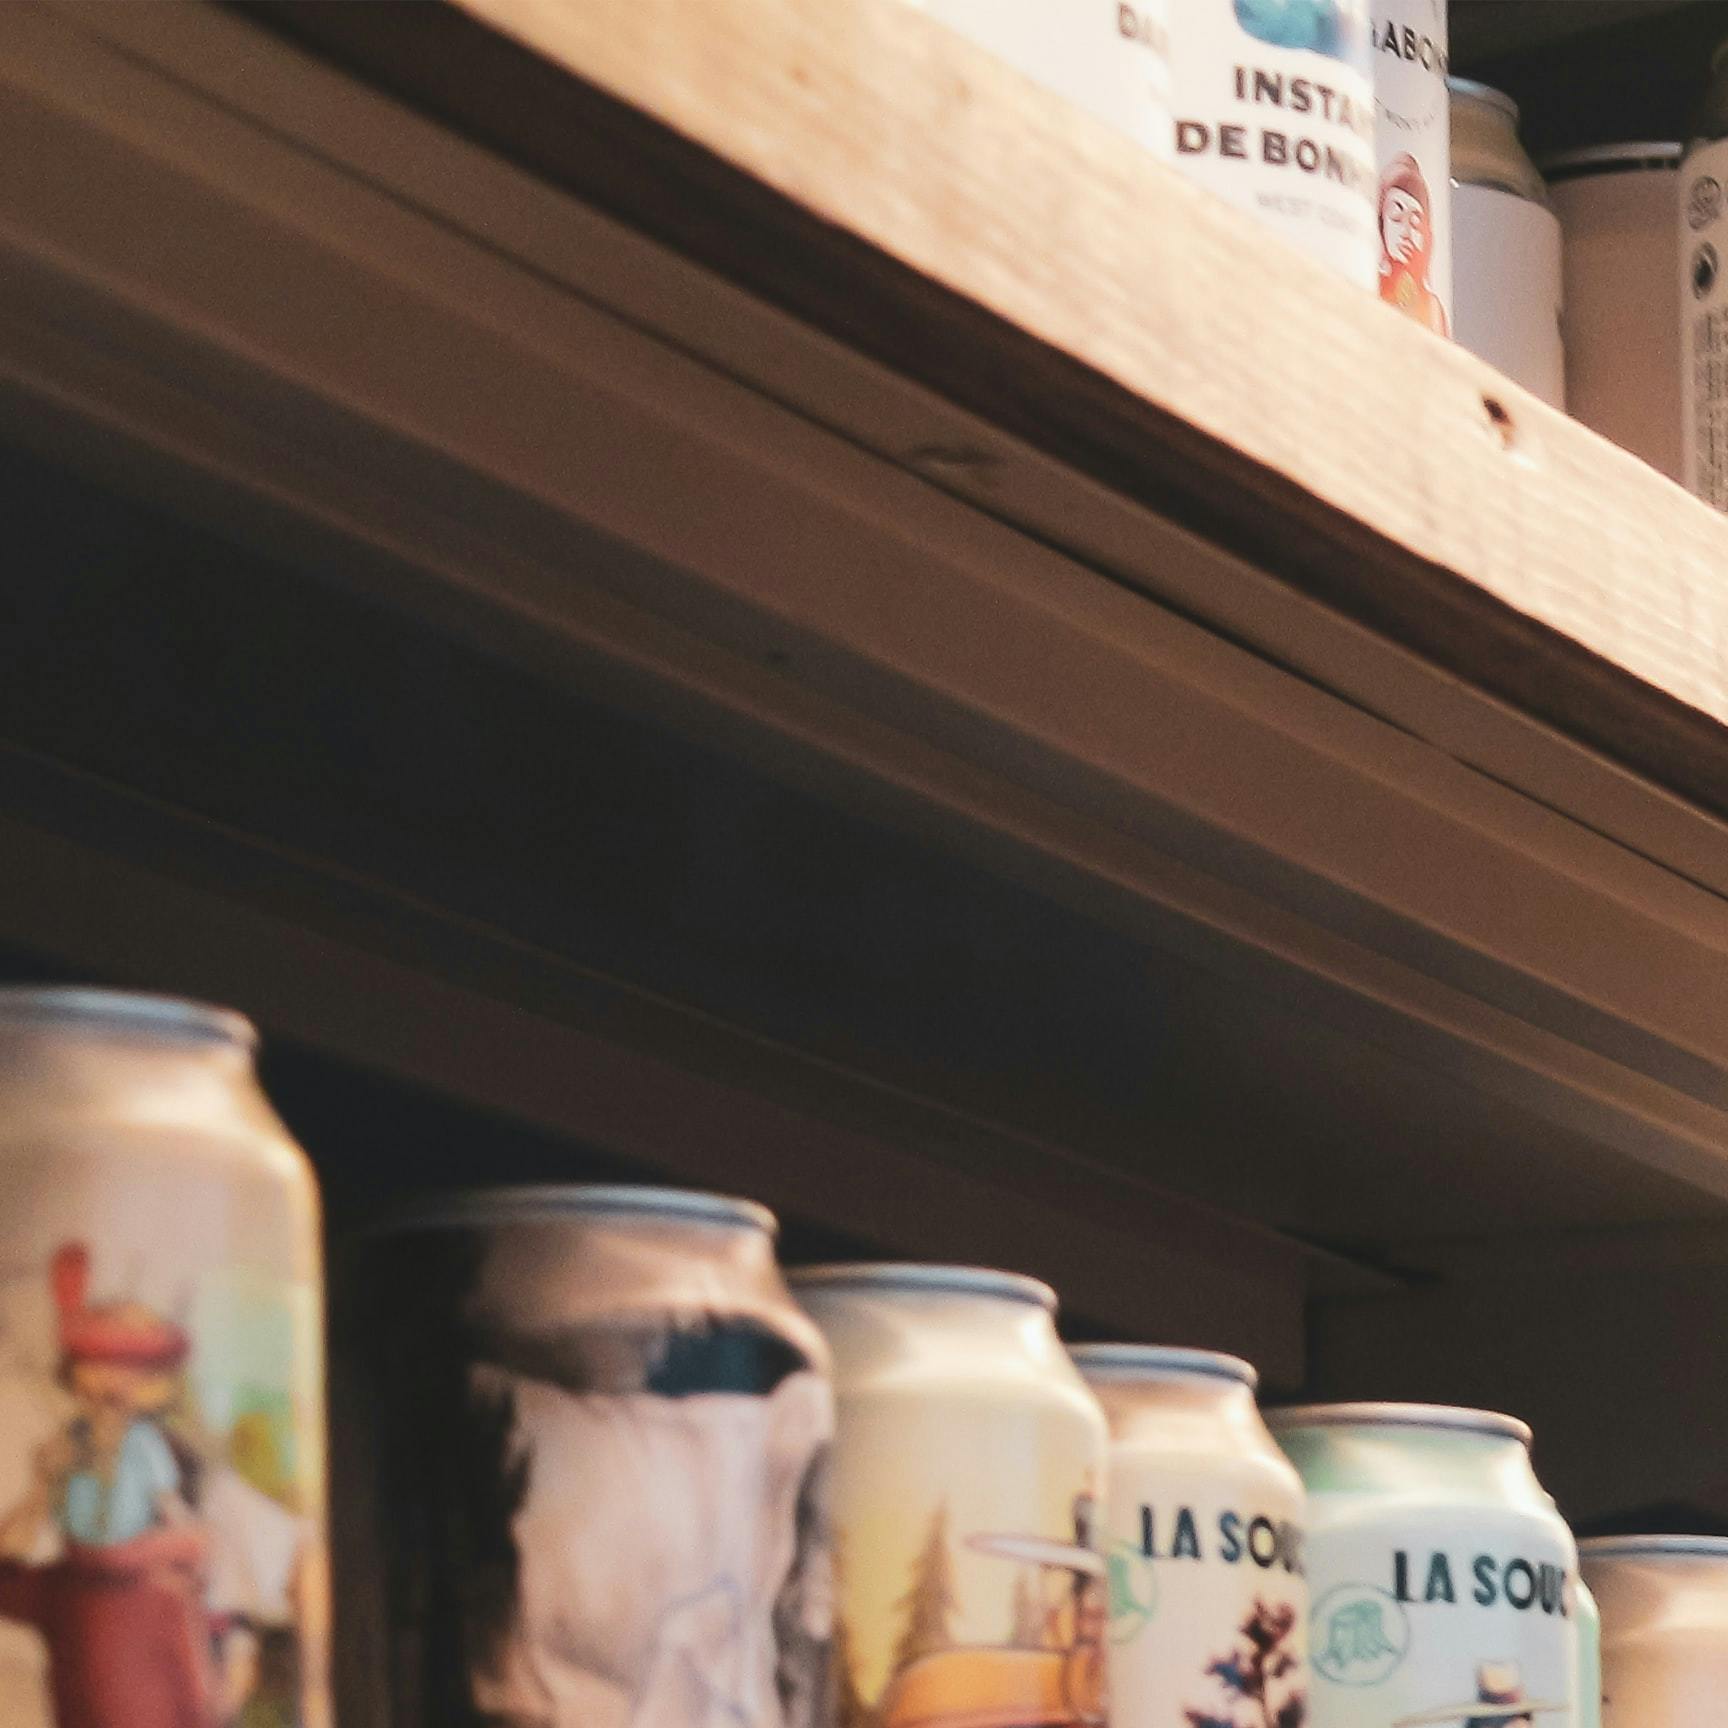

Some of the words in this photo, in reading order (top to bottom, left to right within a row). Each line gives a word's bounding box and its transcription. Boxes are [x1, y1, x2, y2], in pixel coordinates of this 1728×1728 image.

[1174, 119, 1247, 160] DE
[1140, 1503, 1202, 1560] LA
[1394, 1550, 1456, 1604] LA
